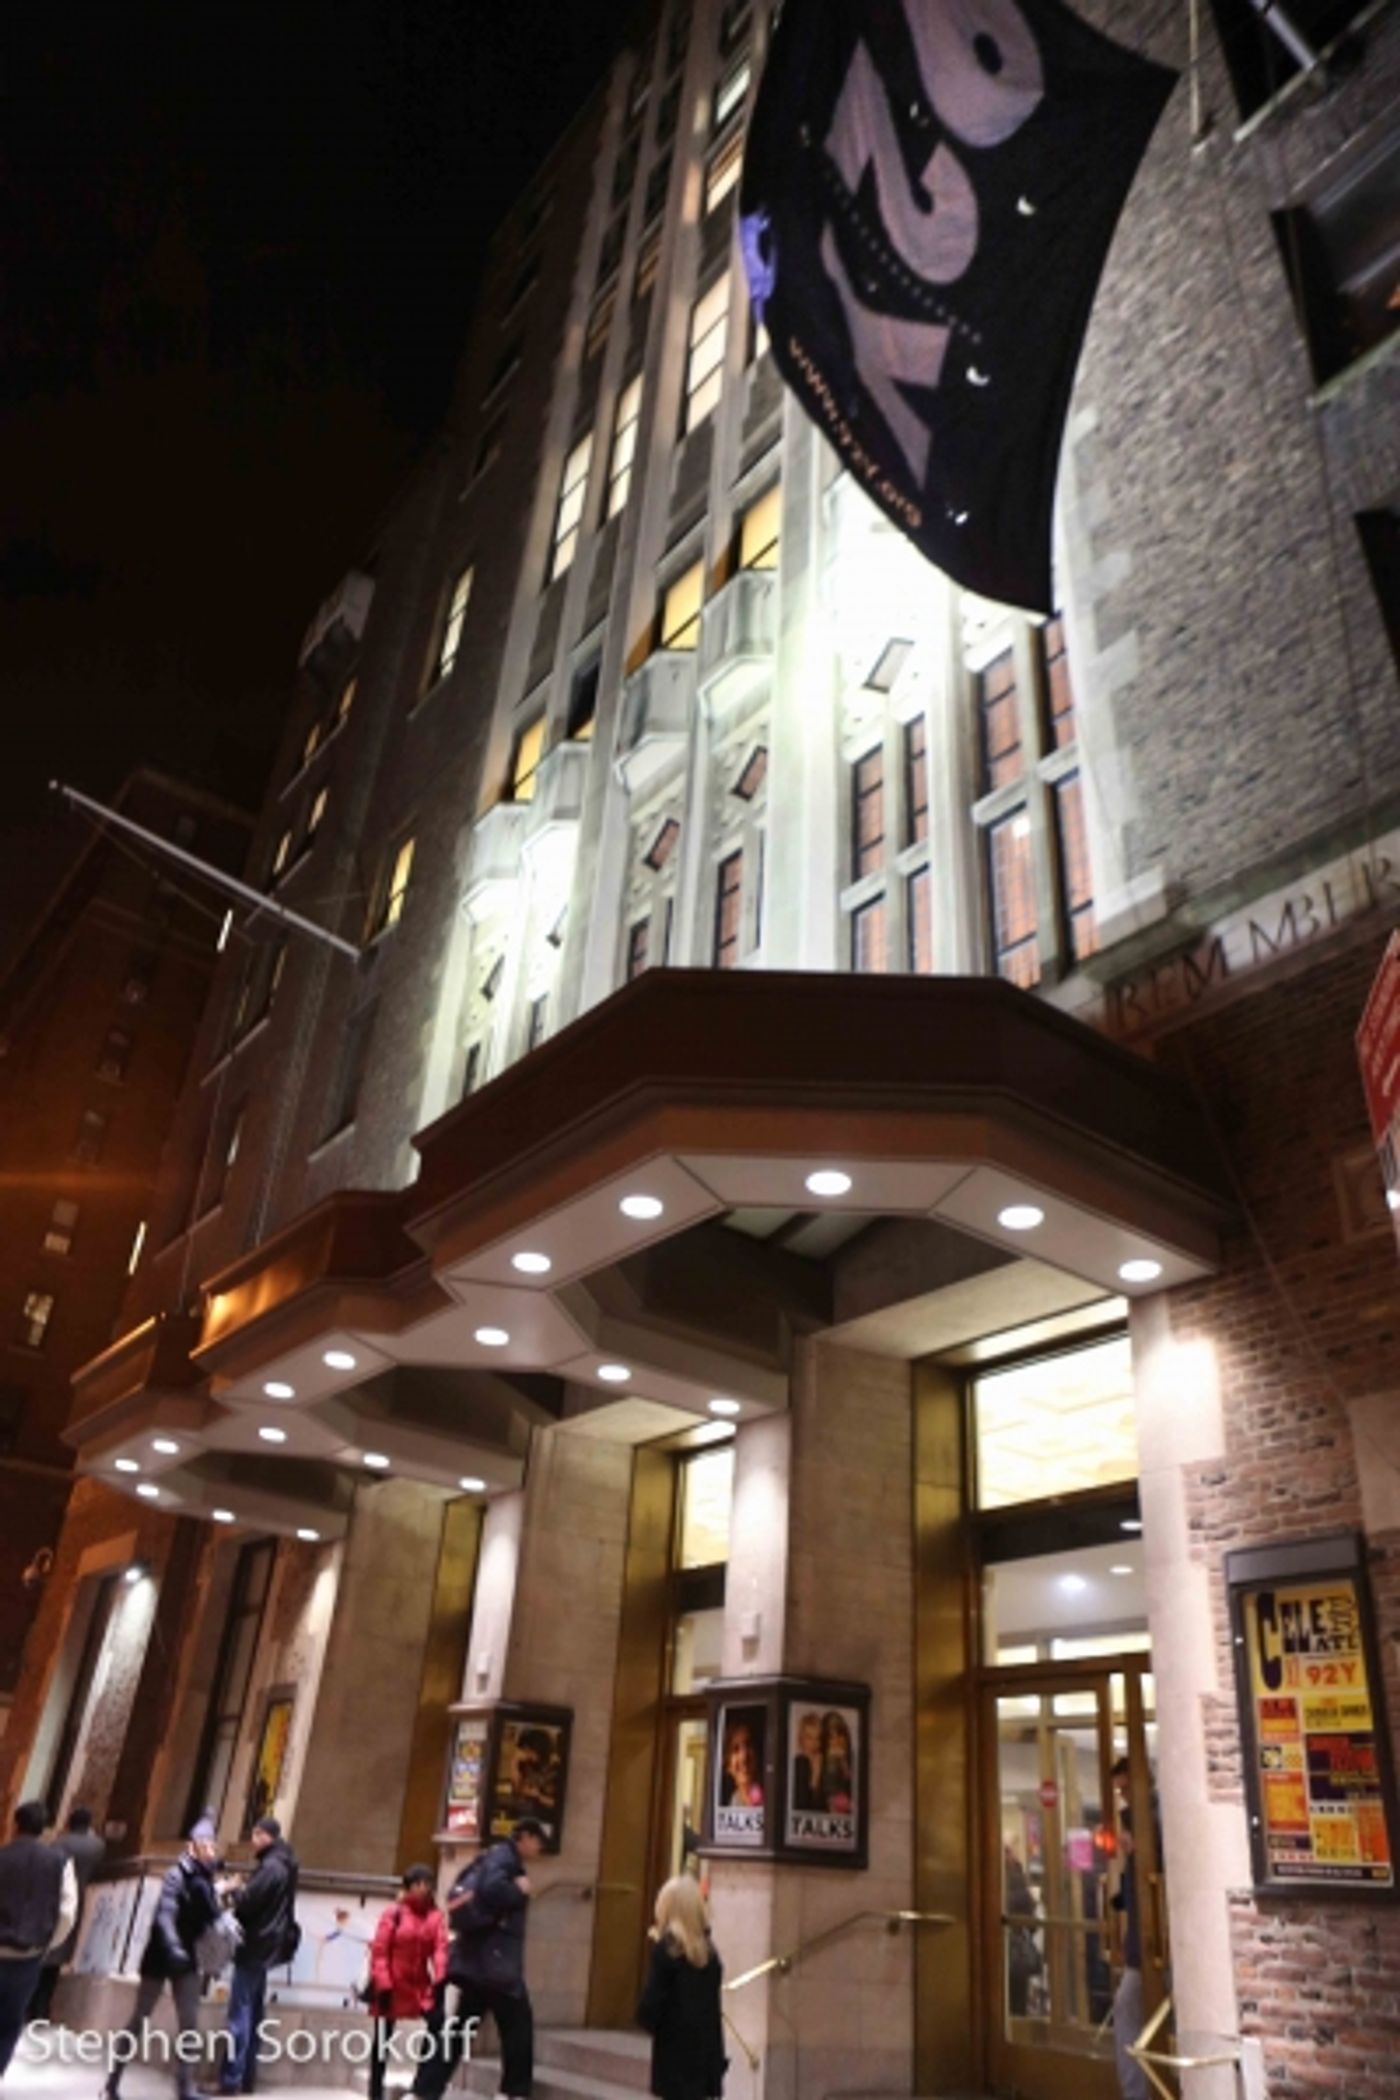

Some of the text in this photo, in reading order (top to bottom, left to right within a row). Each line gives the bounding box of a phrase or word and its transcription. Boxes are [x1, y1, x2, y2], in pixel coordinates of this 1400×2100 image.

[1305, 1661, 1357, 1686] 92Y
[718, 1812, 764, 1833] TALKS
[791, 1816, 853, 1839] TALKS
